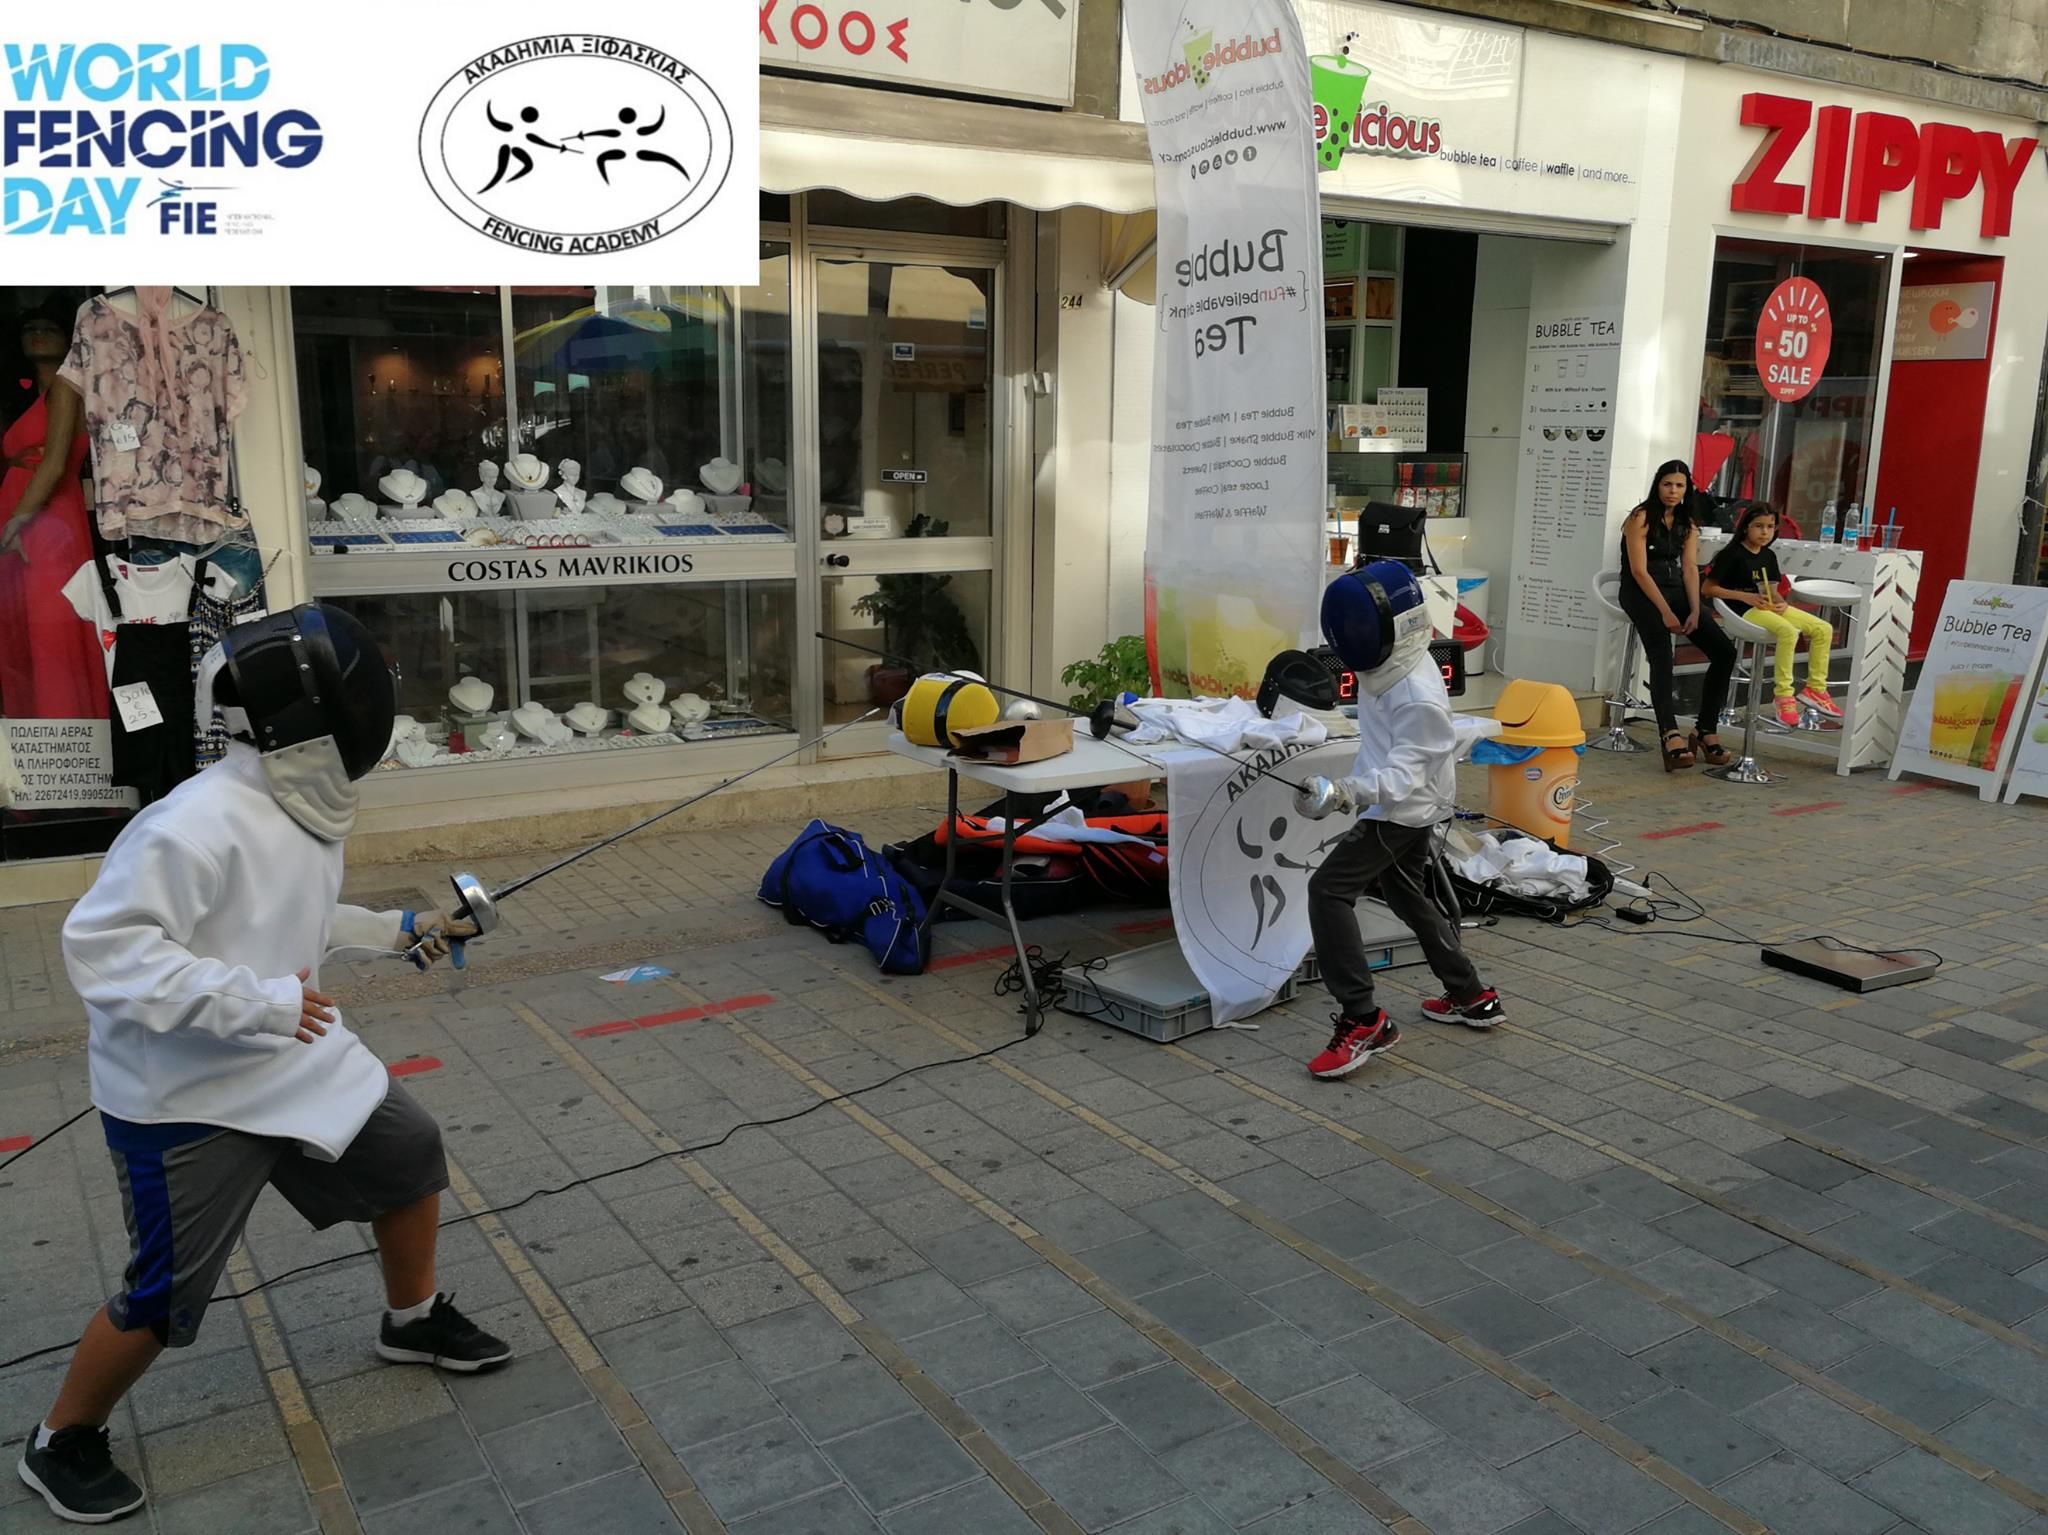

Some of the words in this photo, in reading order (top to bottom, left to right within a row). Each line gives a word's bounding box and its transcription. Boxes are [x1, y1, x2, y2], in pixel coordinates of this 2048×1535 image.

[1351, 105, 1442, 155] icious
[1440, 149, 1477, 165] bubble
[1479, 153, 1497, 168] tea
[1504, 156, 1538, 173] coffee
[1546, 160, 1576, 177] waffle
[1583, 166, 1602, 181] and
[1604, 169, 1637, 185] more...
[1730, 91, 2040, 240] ZIPPY
[1061, 295, 1083, 310] 244
[1786, 313, 1799, 325] UP
[1798, 314, 1810, 327] TO
[1535, 321, 1583, 339] BUBBLE
[1589, 320, 1615, 337] TEA
[1767, 364, 1812, 386] SALE
[892, 471, 916, 481] OPEN
[447, 558, 548, 582] COSTAS
[558, 553, 694, 578] MAVRIKIOS
[1943, 615, 1998, 637] Bubble
[2000, 623, 2032, 643] Tea
[1340, 672, 1354, 698] 2
[10, 726, 59, 738] ΠΩΛΕΙΤΑΙ
[60, 726, 94, 738] ΑΕΡΑΣ
[10, 742, 92, 754] ΚΑΤΑΣΤΗΜΑΤΟΣ
[27, 757, 101, 770] ΠΛΗΡΟΦΟΡΙΕΣ
[37, 773, 58, 786] ΤΟΥ
[12, 789, 33, 802] ΗΛ:
